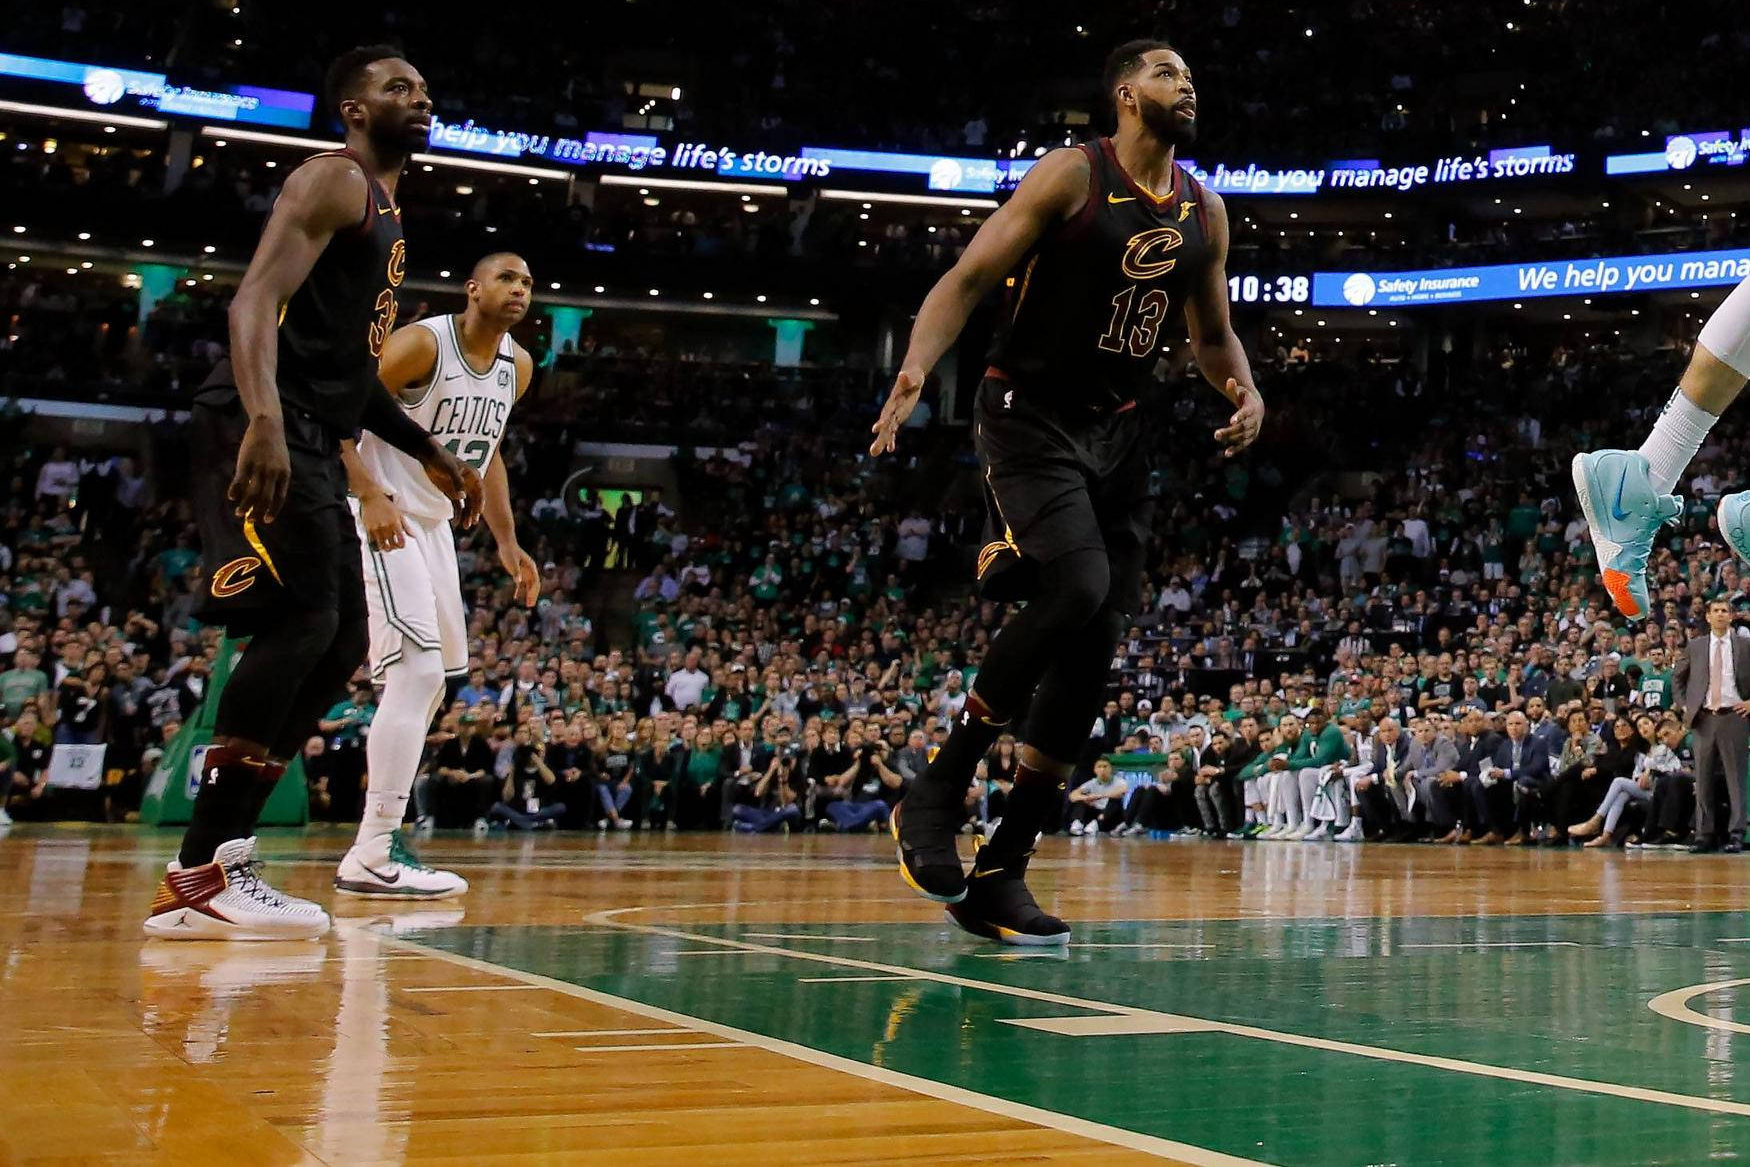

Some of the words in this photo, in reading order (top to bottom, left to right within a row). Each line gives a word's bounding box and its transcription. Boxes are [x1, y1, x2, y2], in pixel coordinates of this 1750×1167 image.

[495, 131, 548, 156] you
[554, 137, 666, 171] manage
[673, 142, 734, 171] life's
[741, 154, 832, 178] storms
[1698, 140, 1738, 156] Safety
[1214, 163, 1269, 191] help
[1278, 167, 1325, 193] you
[1331, 164, 1428, 190] manage
[1435, 156, 1489, 183] life's
[1493, 153, 1575, 178] storms
[1228, 275, 1309, 303] 10:38
[1377, 279, 1418, 295] Safety
[1419, 274, 1480, 291] Insurance
[1519, 266, 1558, 291] We
[1564, 261, 1618, 291] help
[1624, 258, 1673, 289] you
[368, 288, 399, 358] 3
[1098, 285, 1169, 357] 13
[431, 395, 506, 439] CELTICS
